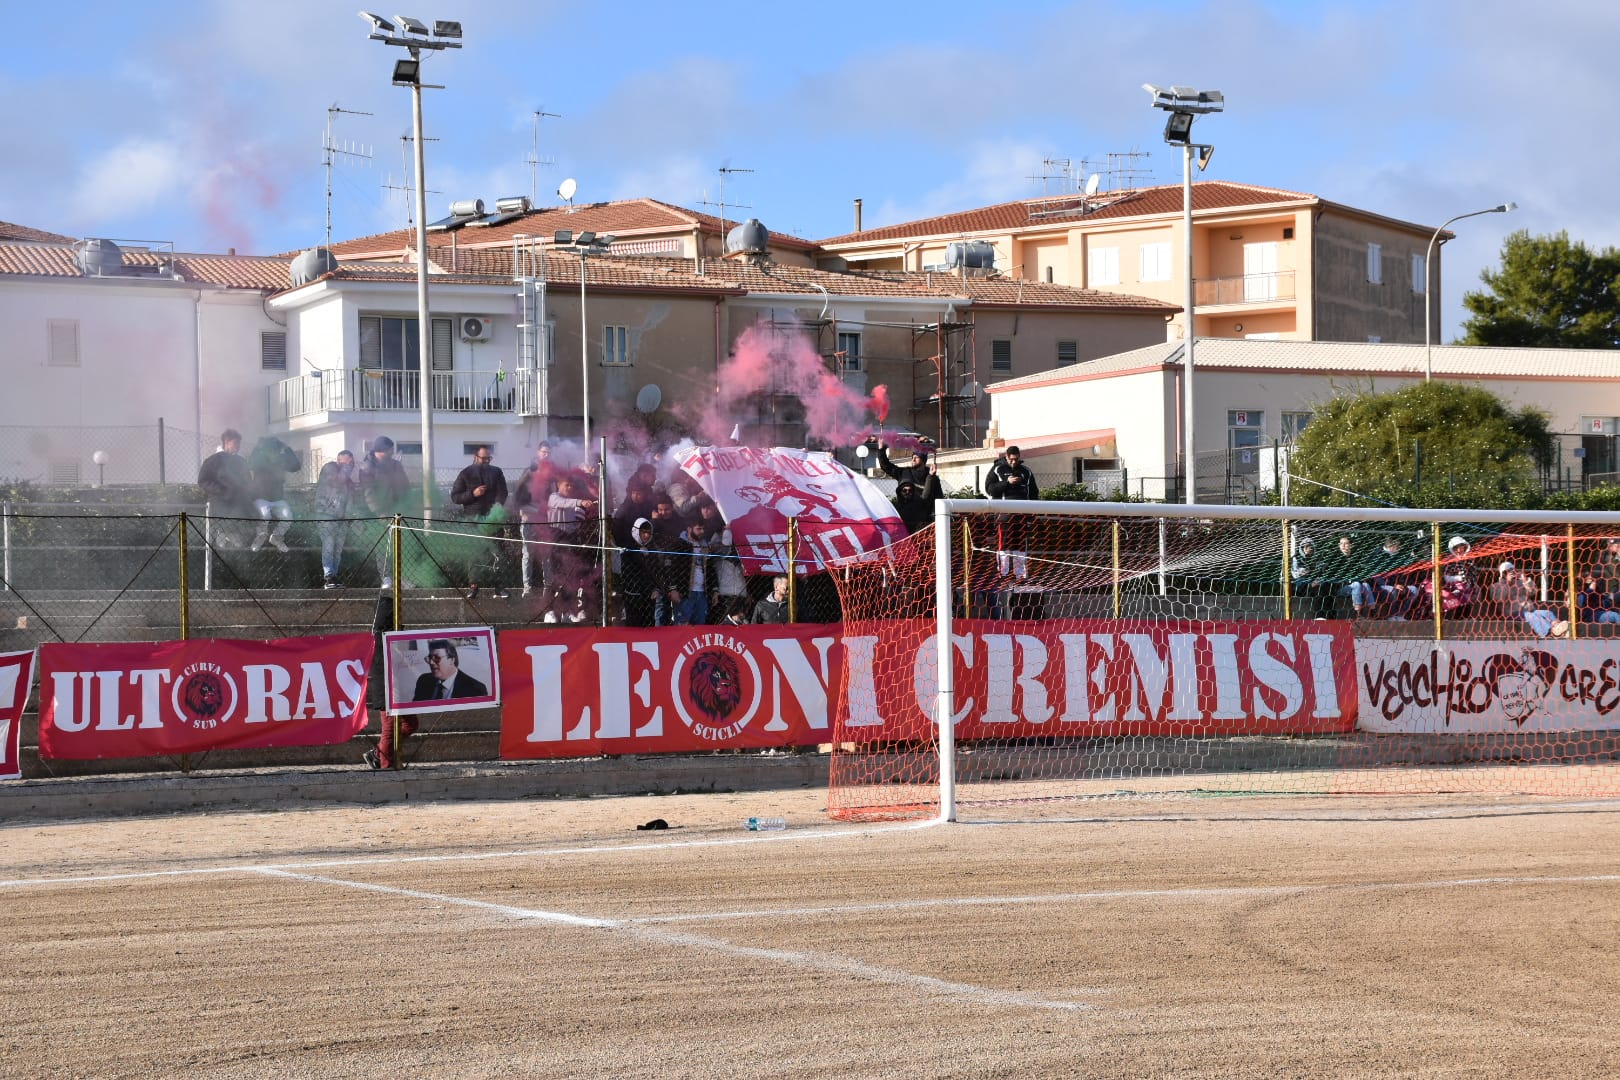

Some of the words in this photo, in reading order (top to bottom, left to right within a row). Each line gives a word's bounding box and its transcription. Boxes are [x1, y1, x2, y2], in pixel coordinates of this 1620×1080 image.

[683, 634, 745, 655] ULTRAS
[184, 662, 221, 676] CURVA
[914, 631, 1342, 726] CREMISI
[193, 718, 217, 730] SUD
[693, 722, 742, 741] SCICLI
